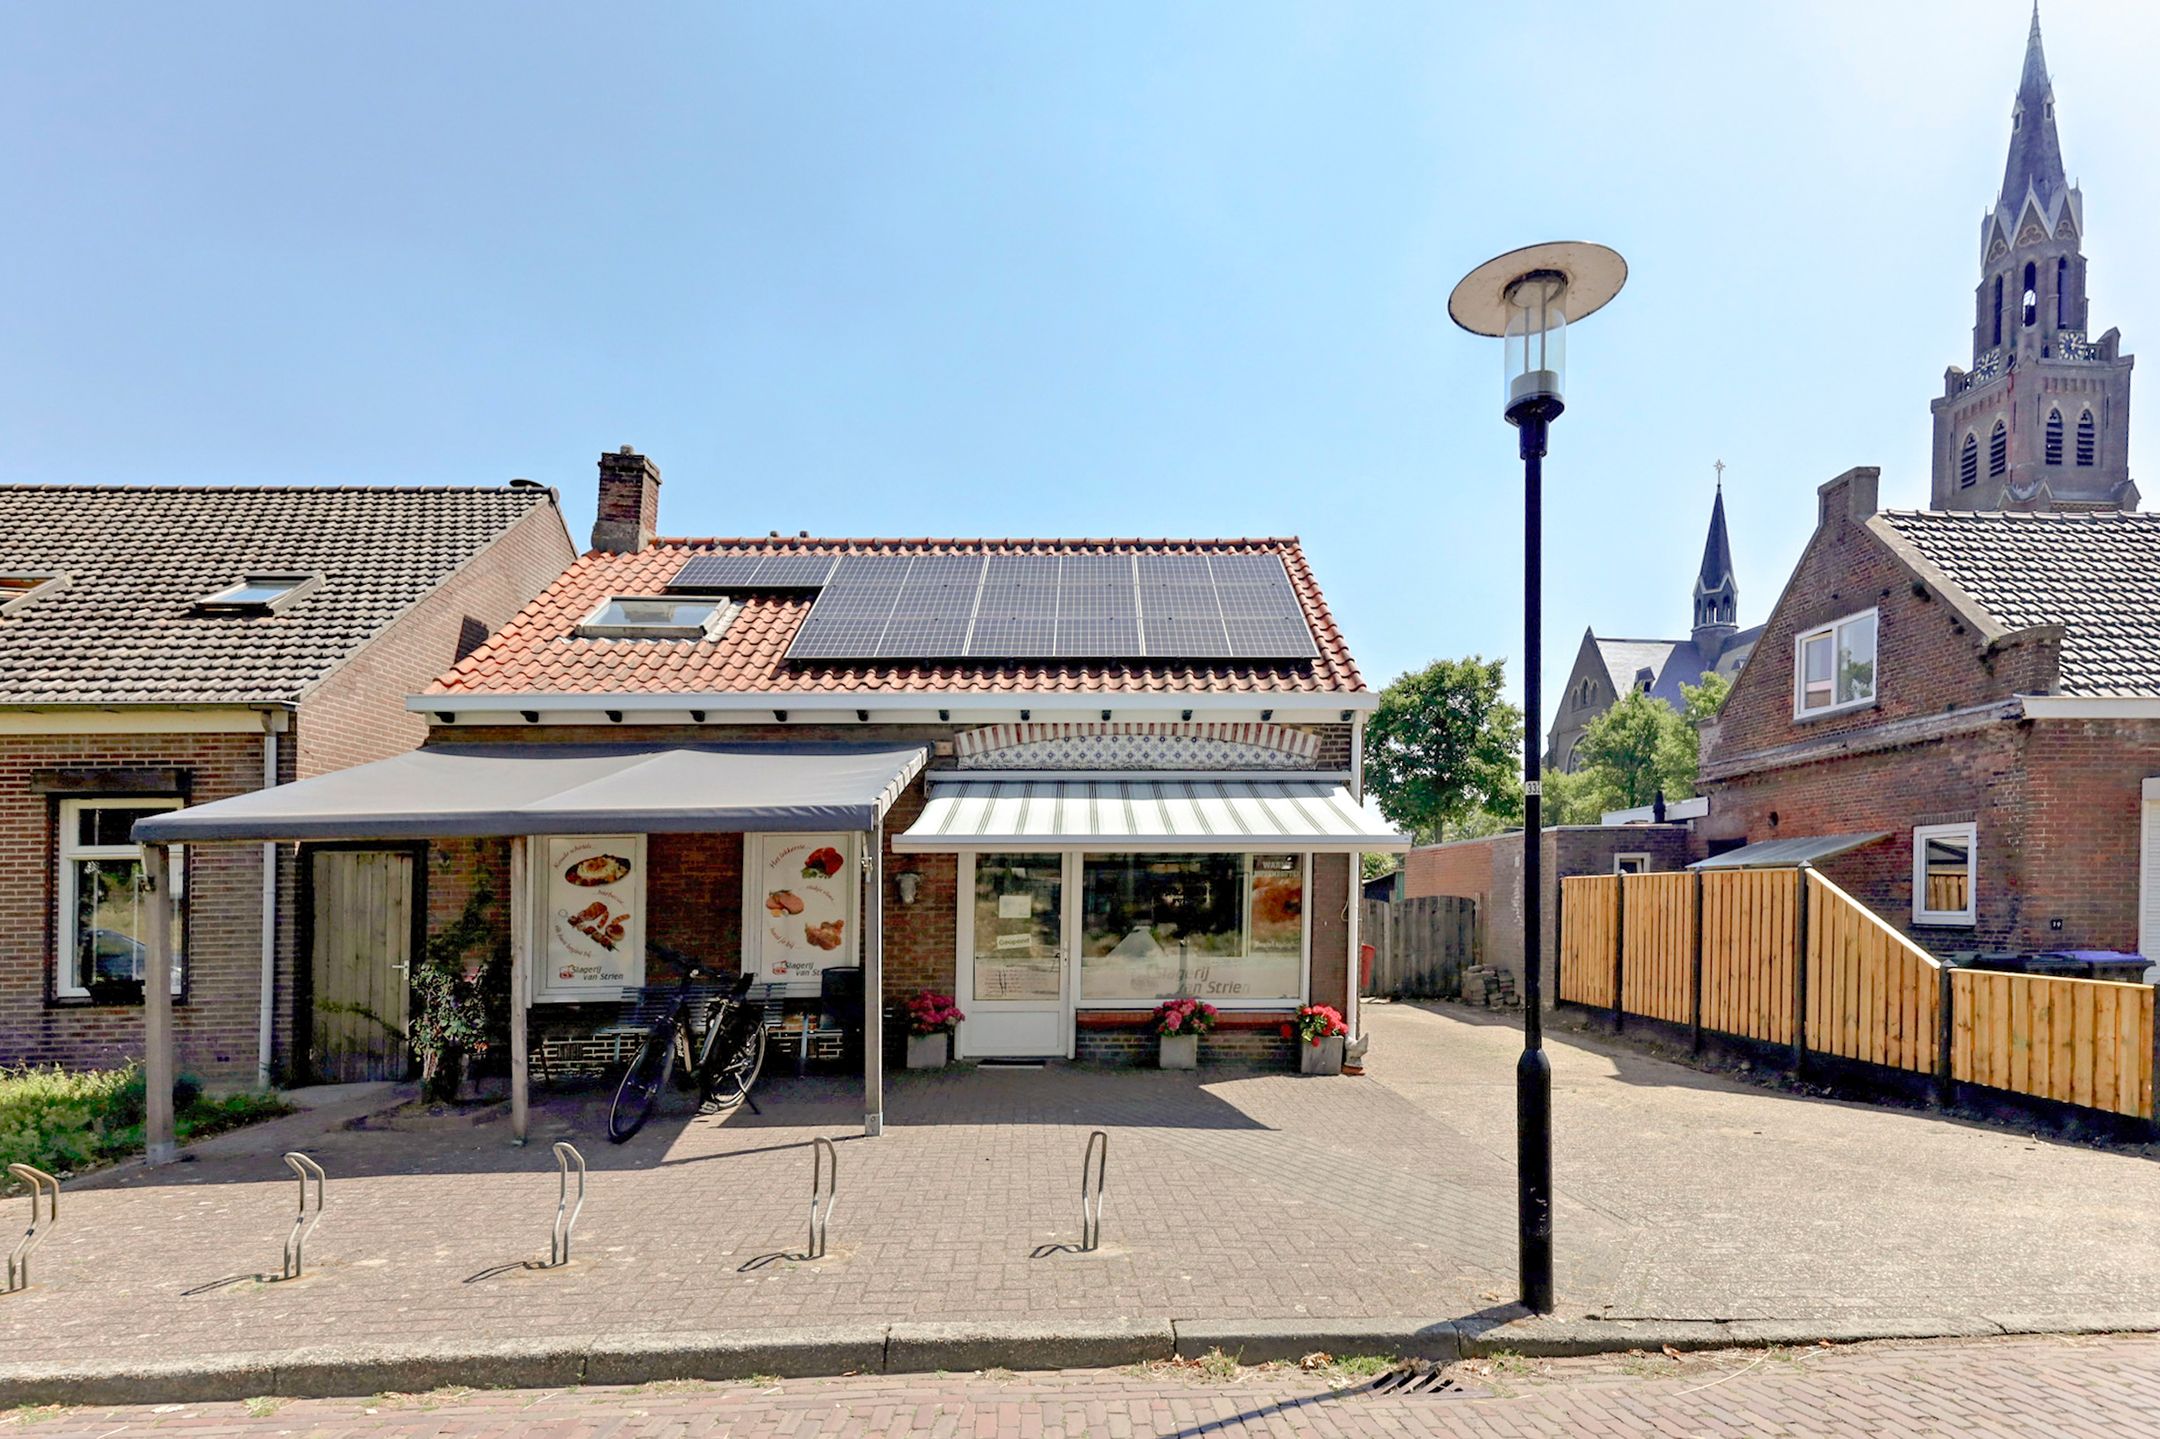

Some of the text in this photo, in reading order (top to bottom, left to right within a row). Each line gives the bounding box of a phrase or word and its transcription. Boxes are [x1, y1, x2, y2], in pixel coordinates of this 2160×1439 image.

[571, 966, 602, 974] Slagerij
[784, 962, 815, 970] Slagerij
[1206, 981, 1250, 994] Strien
